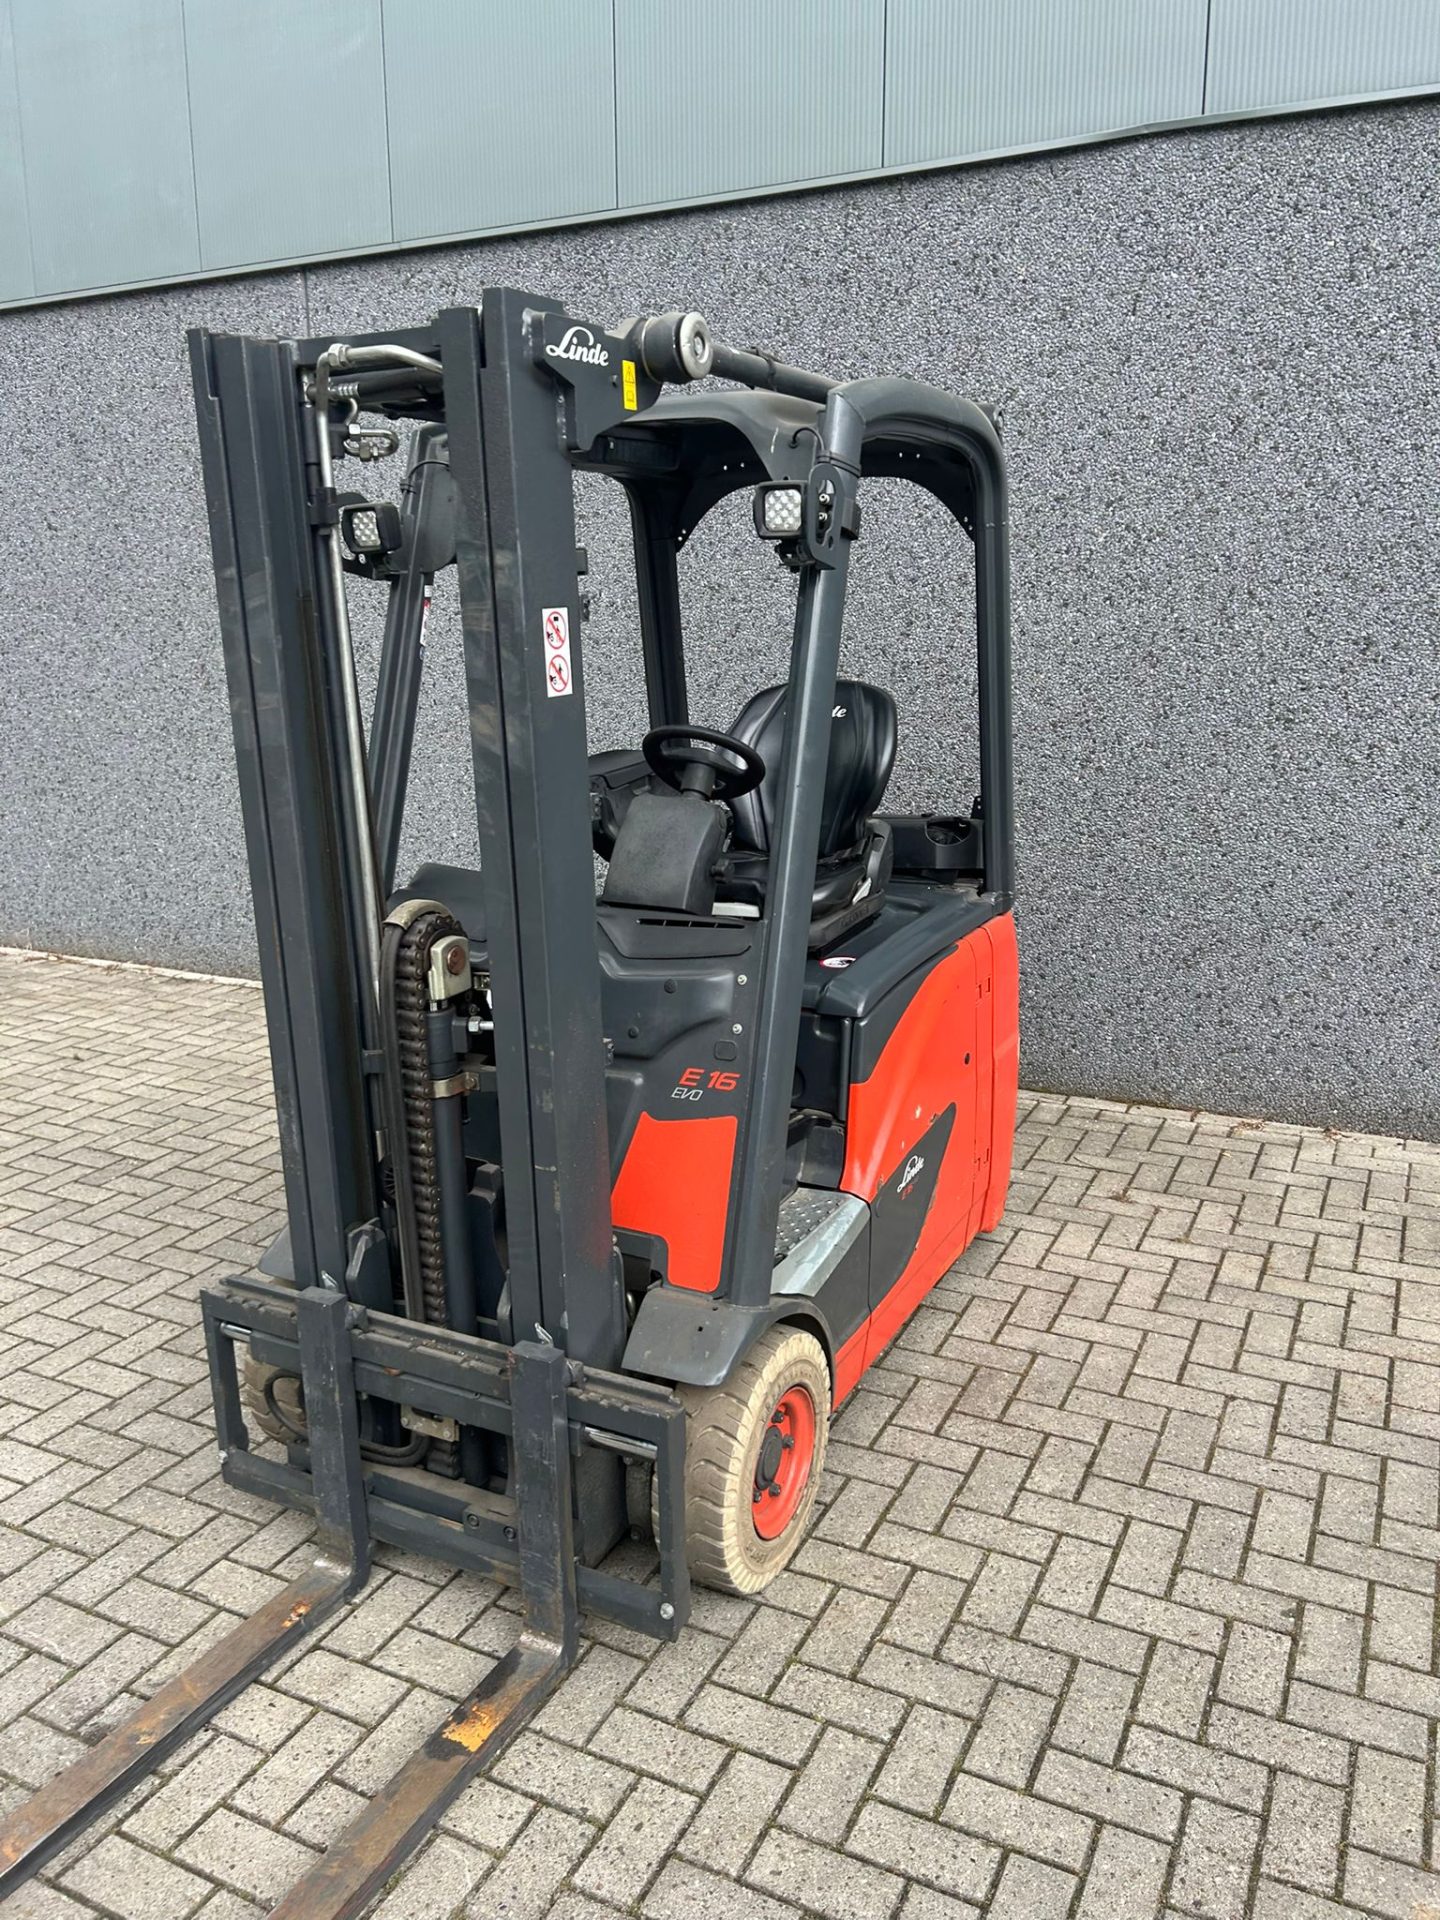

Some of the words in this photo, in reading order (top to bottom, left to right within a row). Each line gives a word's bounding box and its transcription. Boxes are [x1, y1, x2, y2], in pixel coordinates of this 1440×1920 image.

[546, 326, 609, 366] Linde
[671, 1087, 704, 1101] EVO
[679, 1067, 705, 1087] E
[707, 1071, 740, 1091] 16
[897, 1155, 924, 1193] Linde
